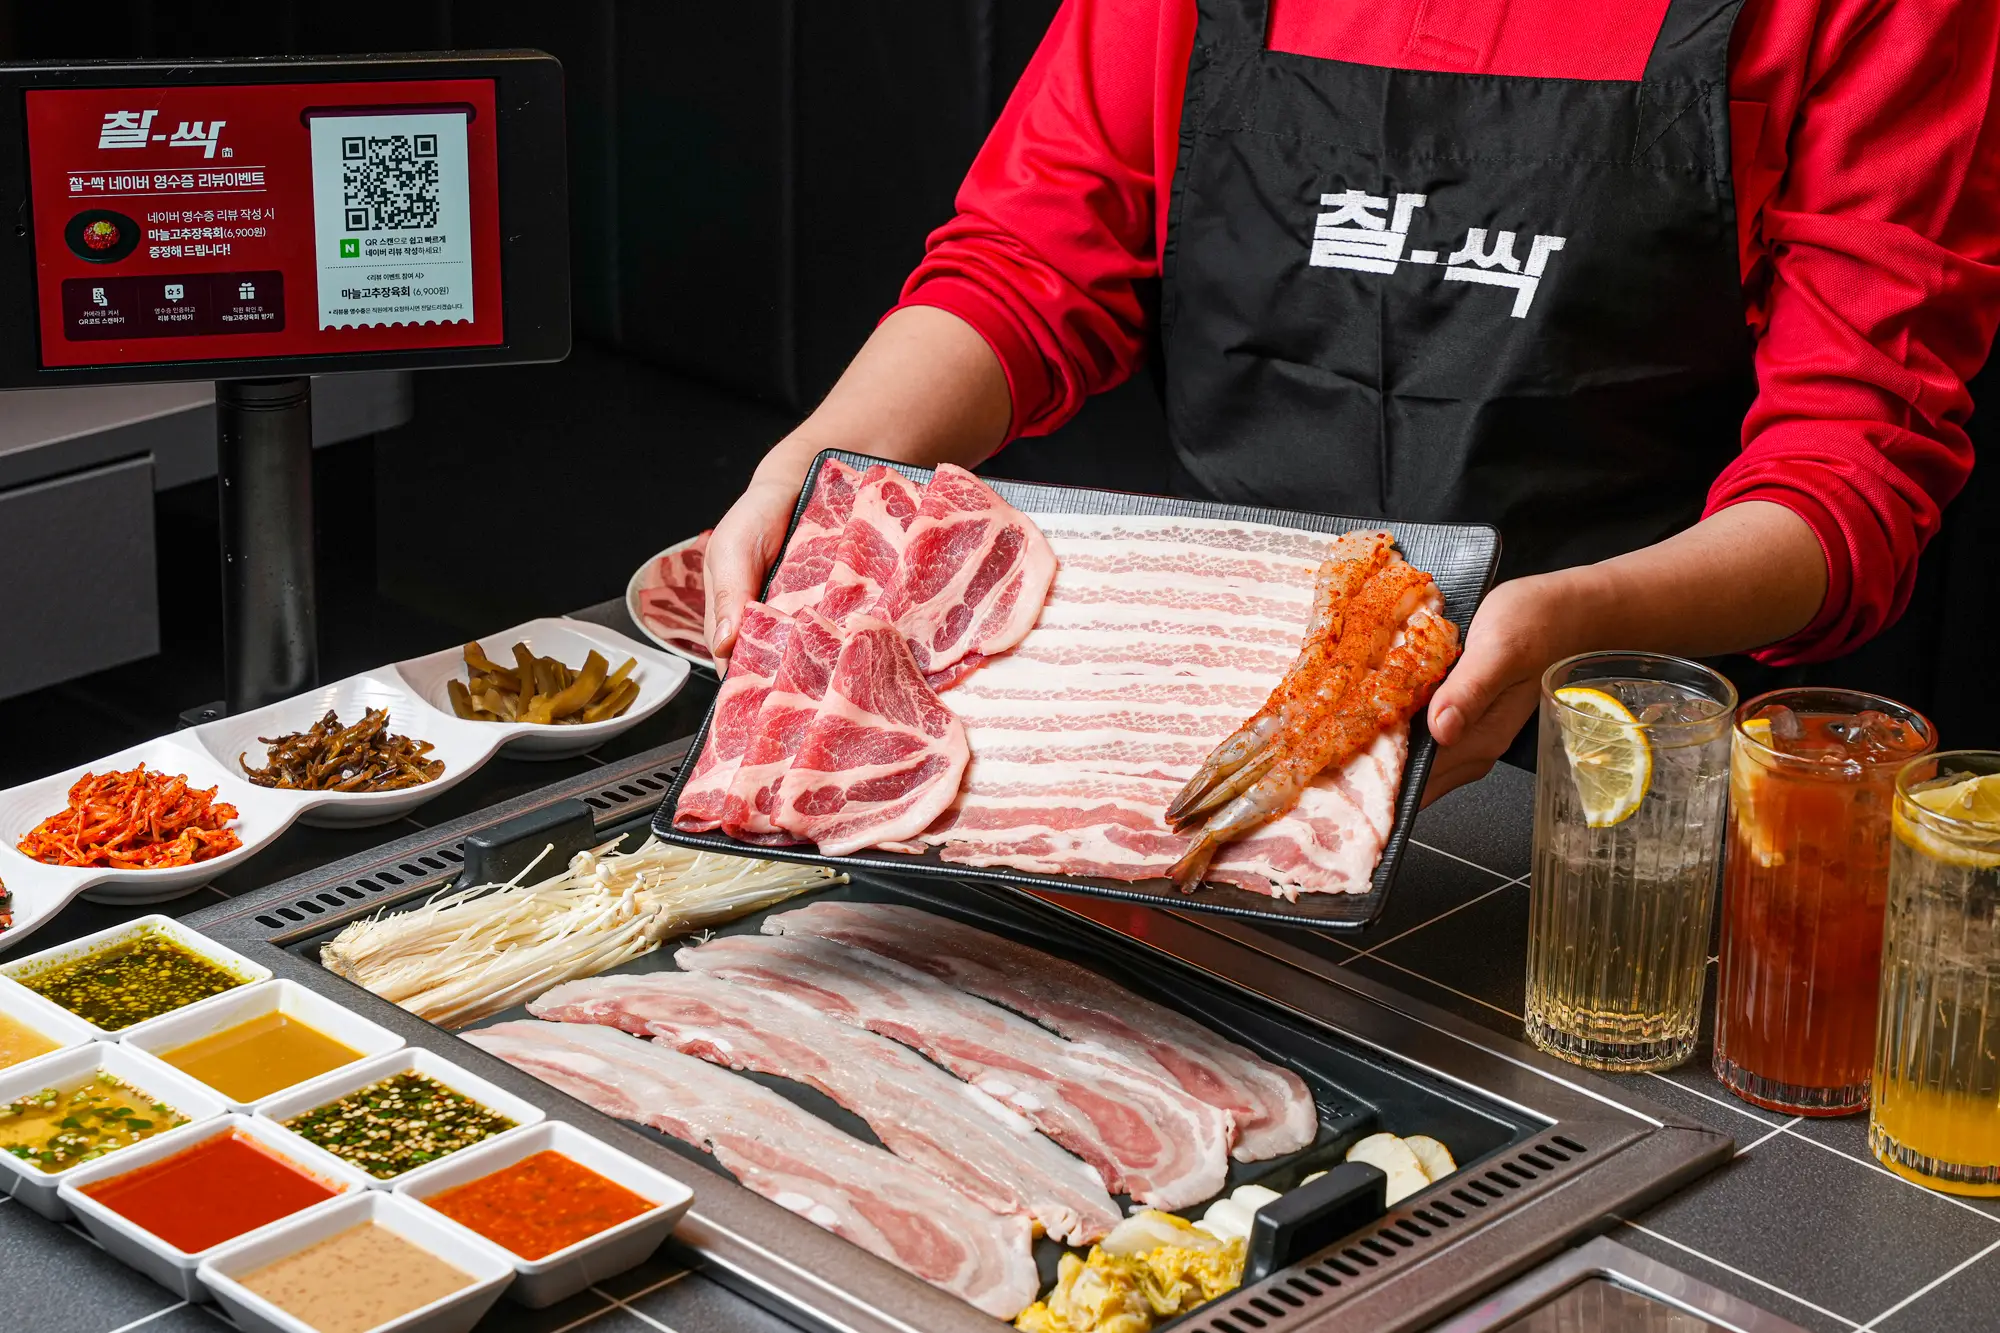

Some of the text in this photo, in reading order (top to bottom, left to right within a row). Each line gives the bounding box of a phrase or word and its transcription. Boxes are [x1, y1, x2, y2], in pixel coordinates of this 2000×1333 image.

[69, 171, 266, 192] 찰-싹 네이버 영수증 리뷰이벤트
[147, 207, 275, 223] 네이버 영수증 리뷰 작성 시
[148, 226, 266, 242] 마늘고추장육회(6,900원)
[379, 237, 408, 246] 스캔으로
[409, 236, 423, 244] 쉽고
[424, 235, 446, 244] 빠르게
[149, 243, 231, 259] 증정해 드립니다!
[345, 243, 355, 253] N
[365, 246, 442, 257] 네이버 리뷰 작성하세요!
[383, 273, 401, 281] 이벤트
[341, 285, 449, 300] 마늘고추장육회 (6,900원)
[157, 314, 170, 322] 리뷰
